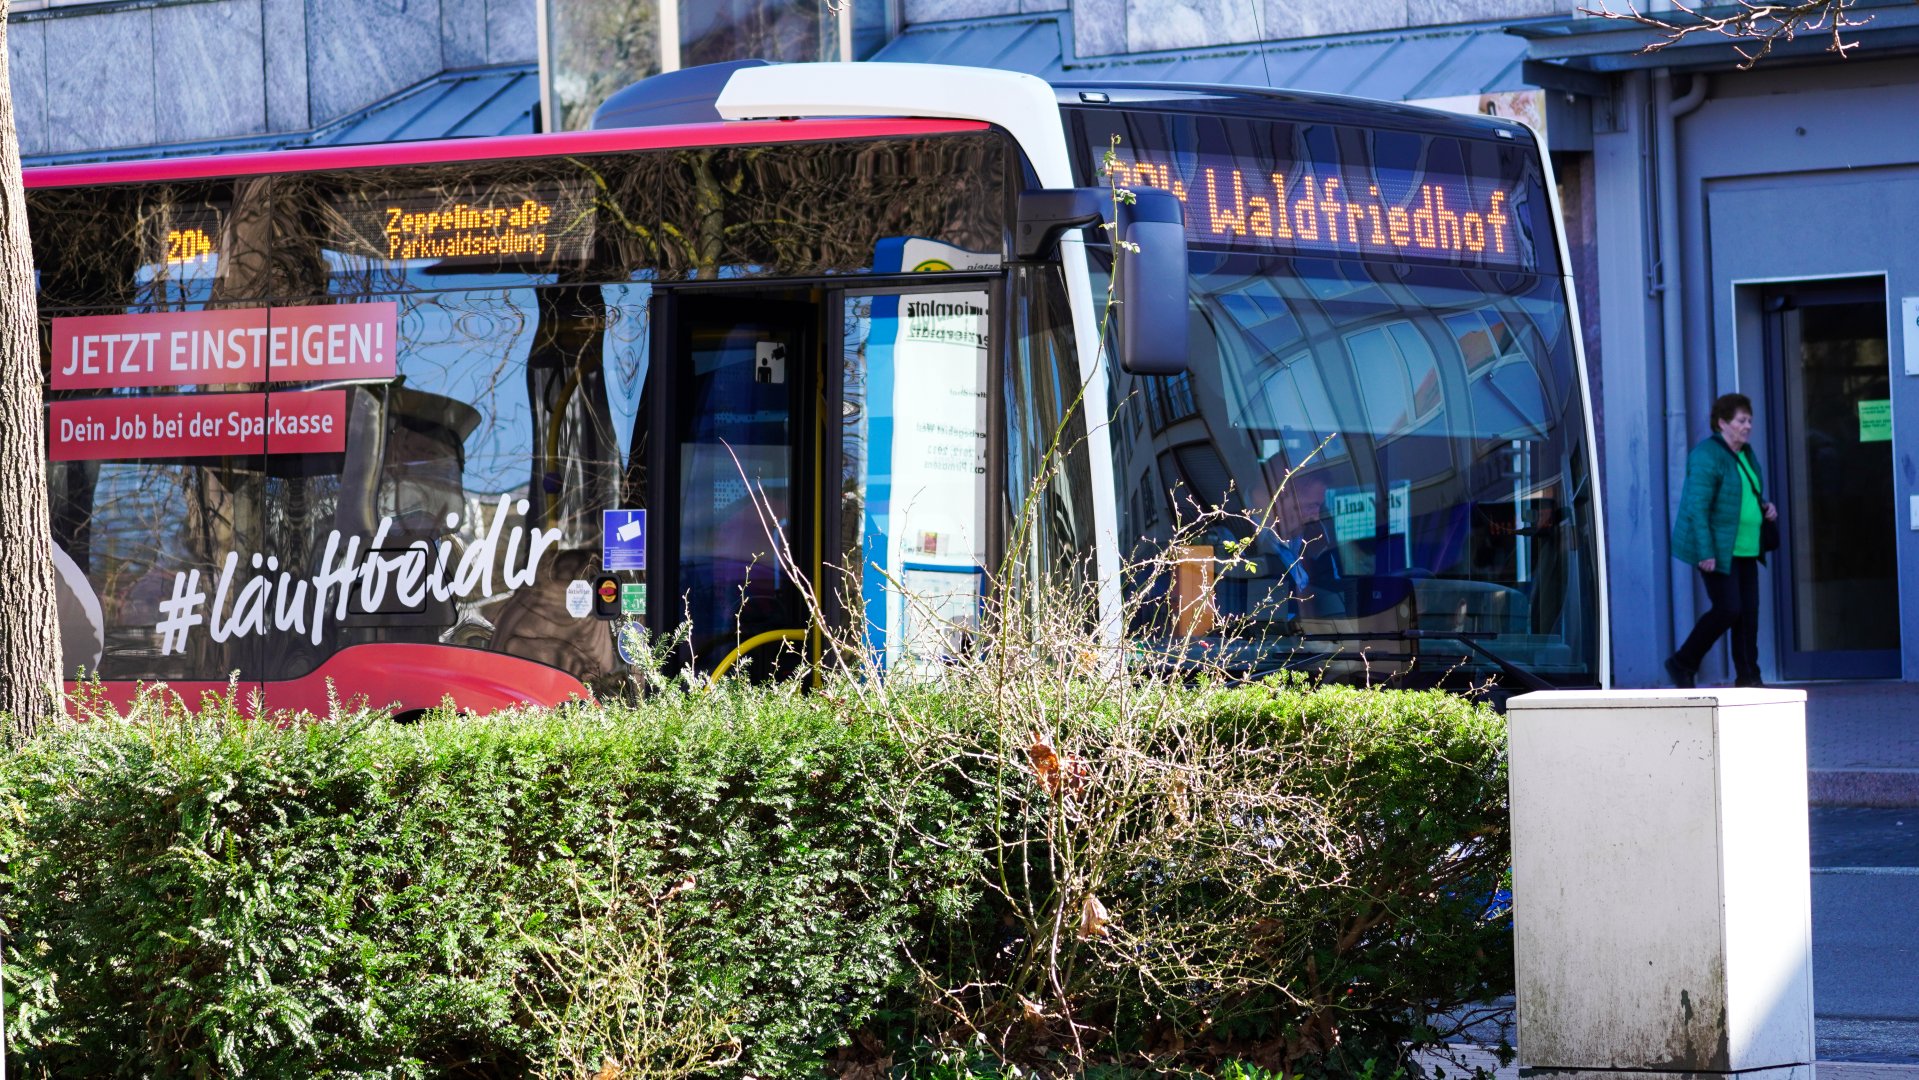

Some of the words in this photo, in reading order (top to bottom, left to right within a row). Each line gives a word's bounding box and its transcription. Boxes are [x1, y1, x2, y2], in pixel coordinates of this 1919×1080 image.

[1206, 168, 1507, 253] Waldfriedhof
[167, 229, 211, 265] 204
[389, 228, 546, 259] Parkwaldsiedlung
[62, 332, 161, 376] JETZT
[169, 322, 384, 371] EINSTEIGEN!
[60, 416, 106, 442] Dein
[110, 414, 147, 440] Job
[152, 413, 184, 439] bei
[189, 411, 223, 437] der
[227, 408, 333, 442] Sparkasse
[1336, 498, 1365, 514] Lina
